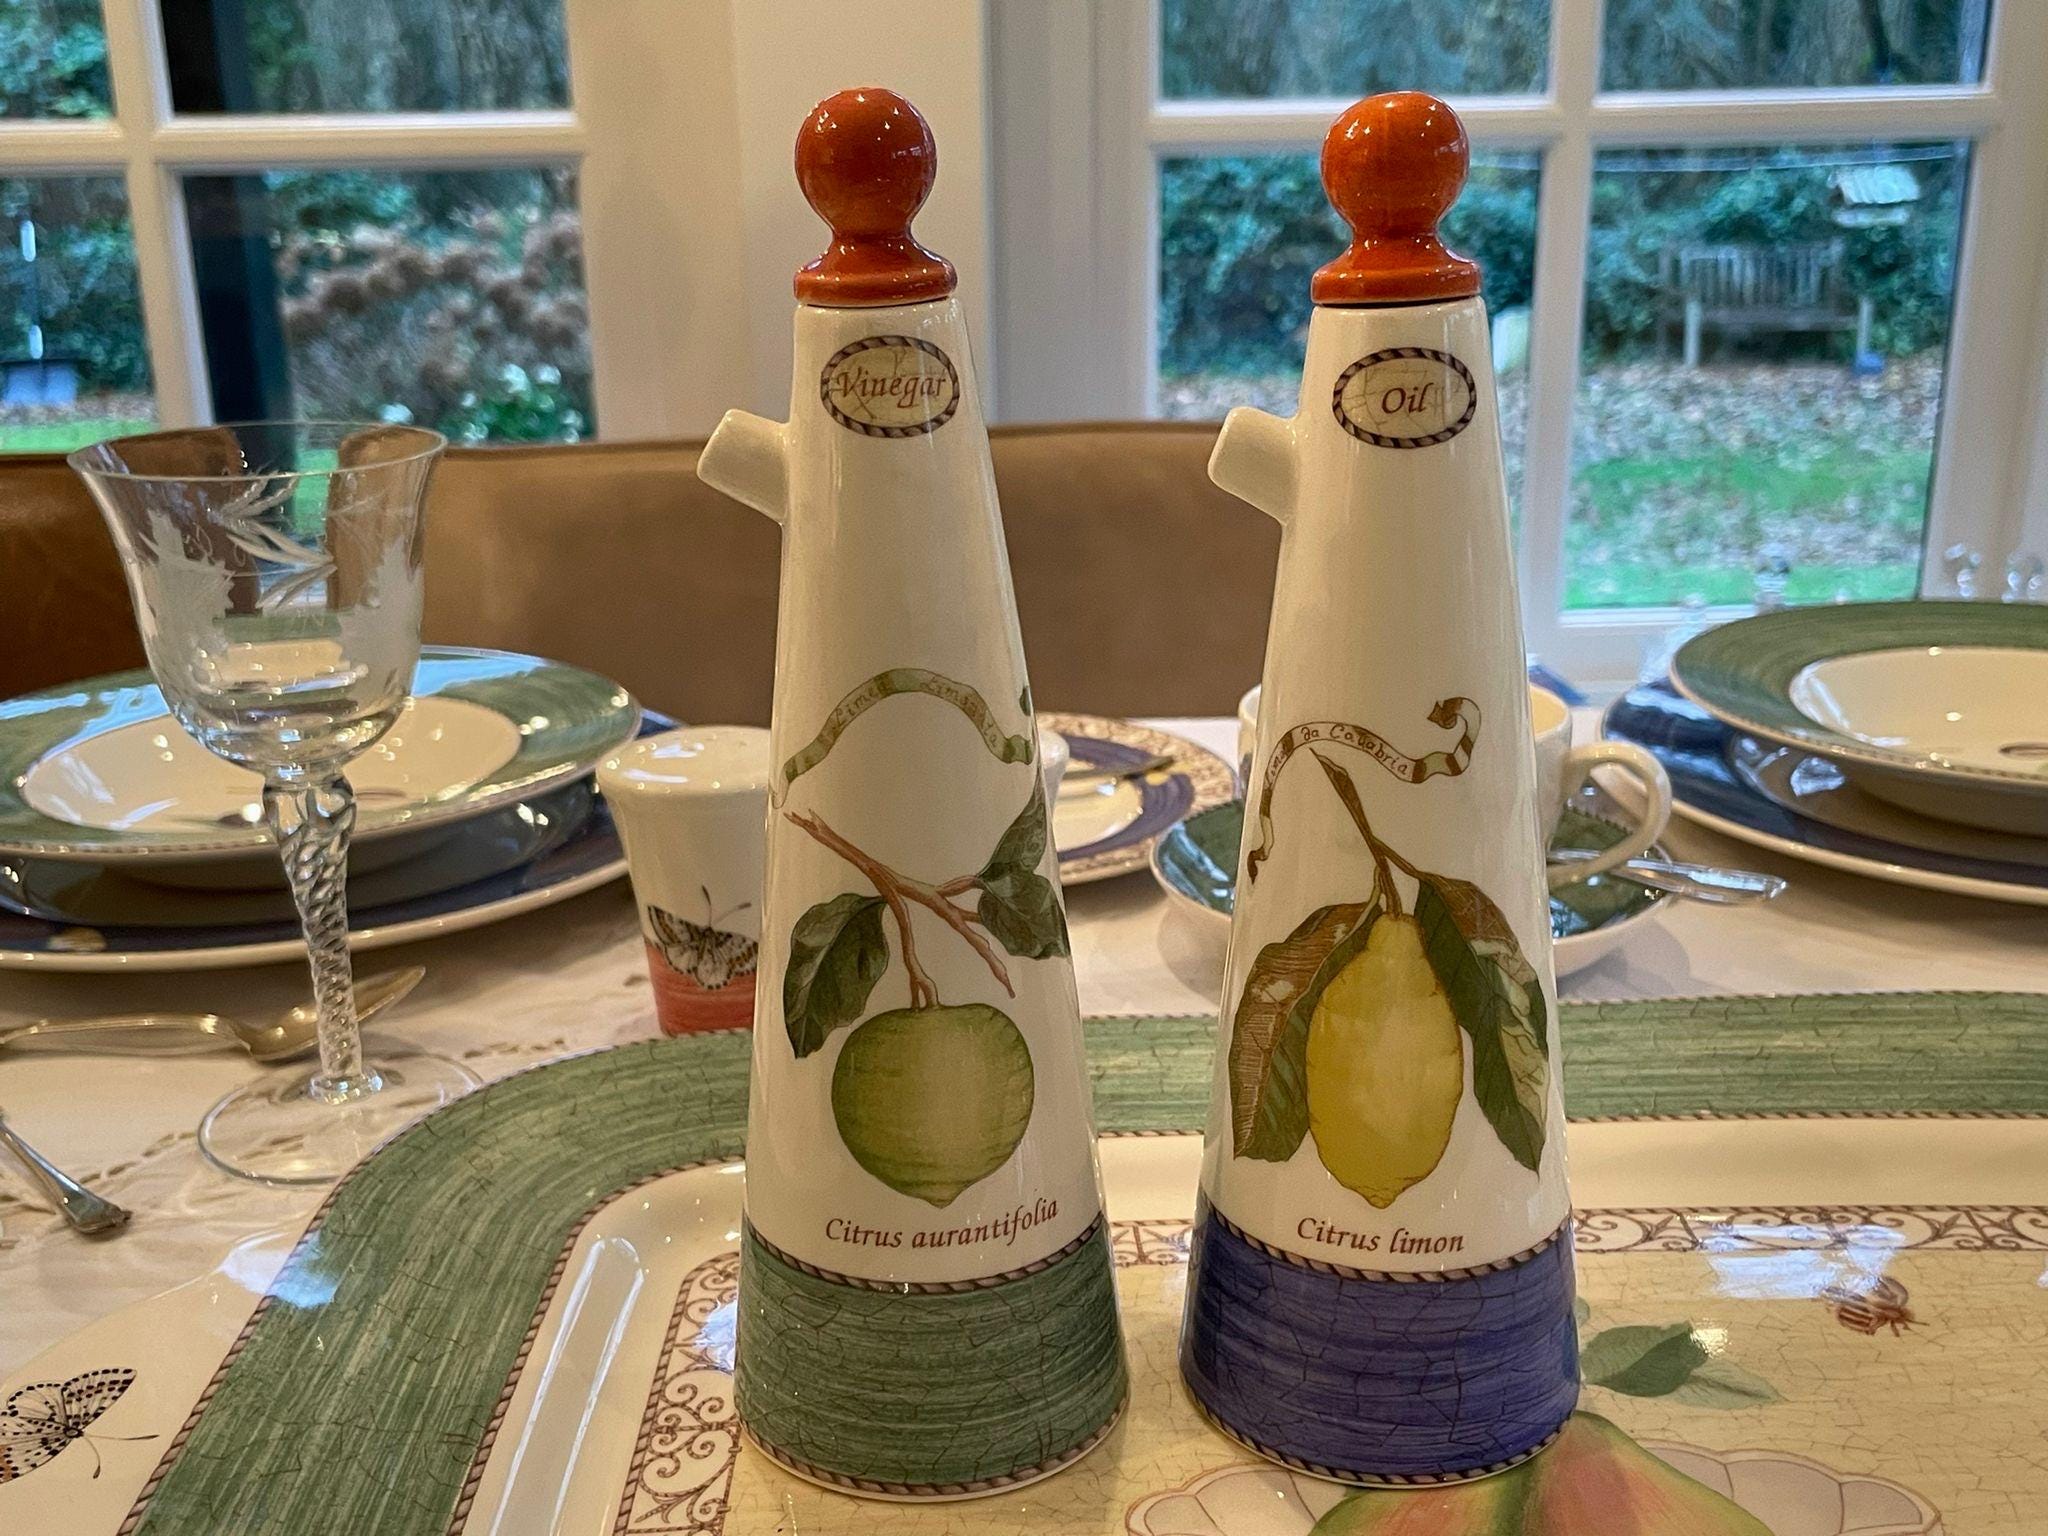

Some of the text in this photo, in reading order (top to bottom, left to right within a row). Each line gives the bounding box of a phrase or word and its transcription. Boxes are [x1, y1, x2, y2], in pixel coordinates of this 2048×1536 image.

[835, 367, 947, 409] Vinegar
[1380, 382, 1435, 415] Oil
[825, 1197, 1060, 1249] Citrus aurantifolia
[1297, 1217, 1465, 1255] Citrus limon
